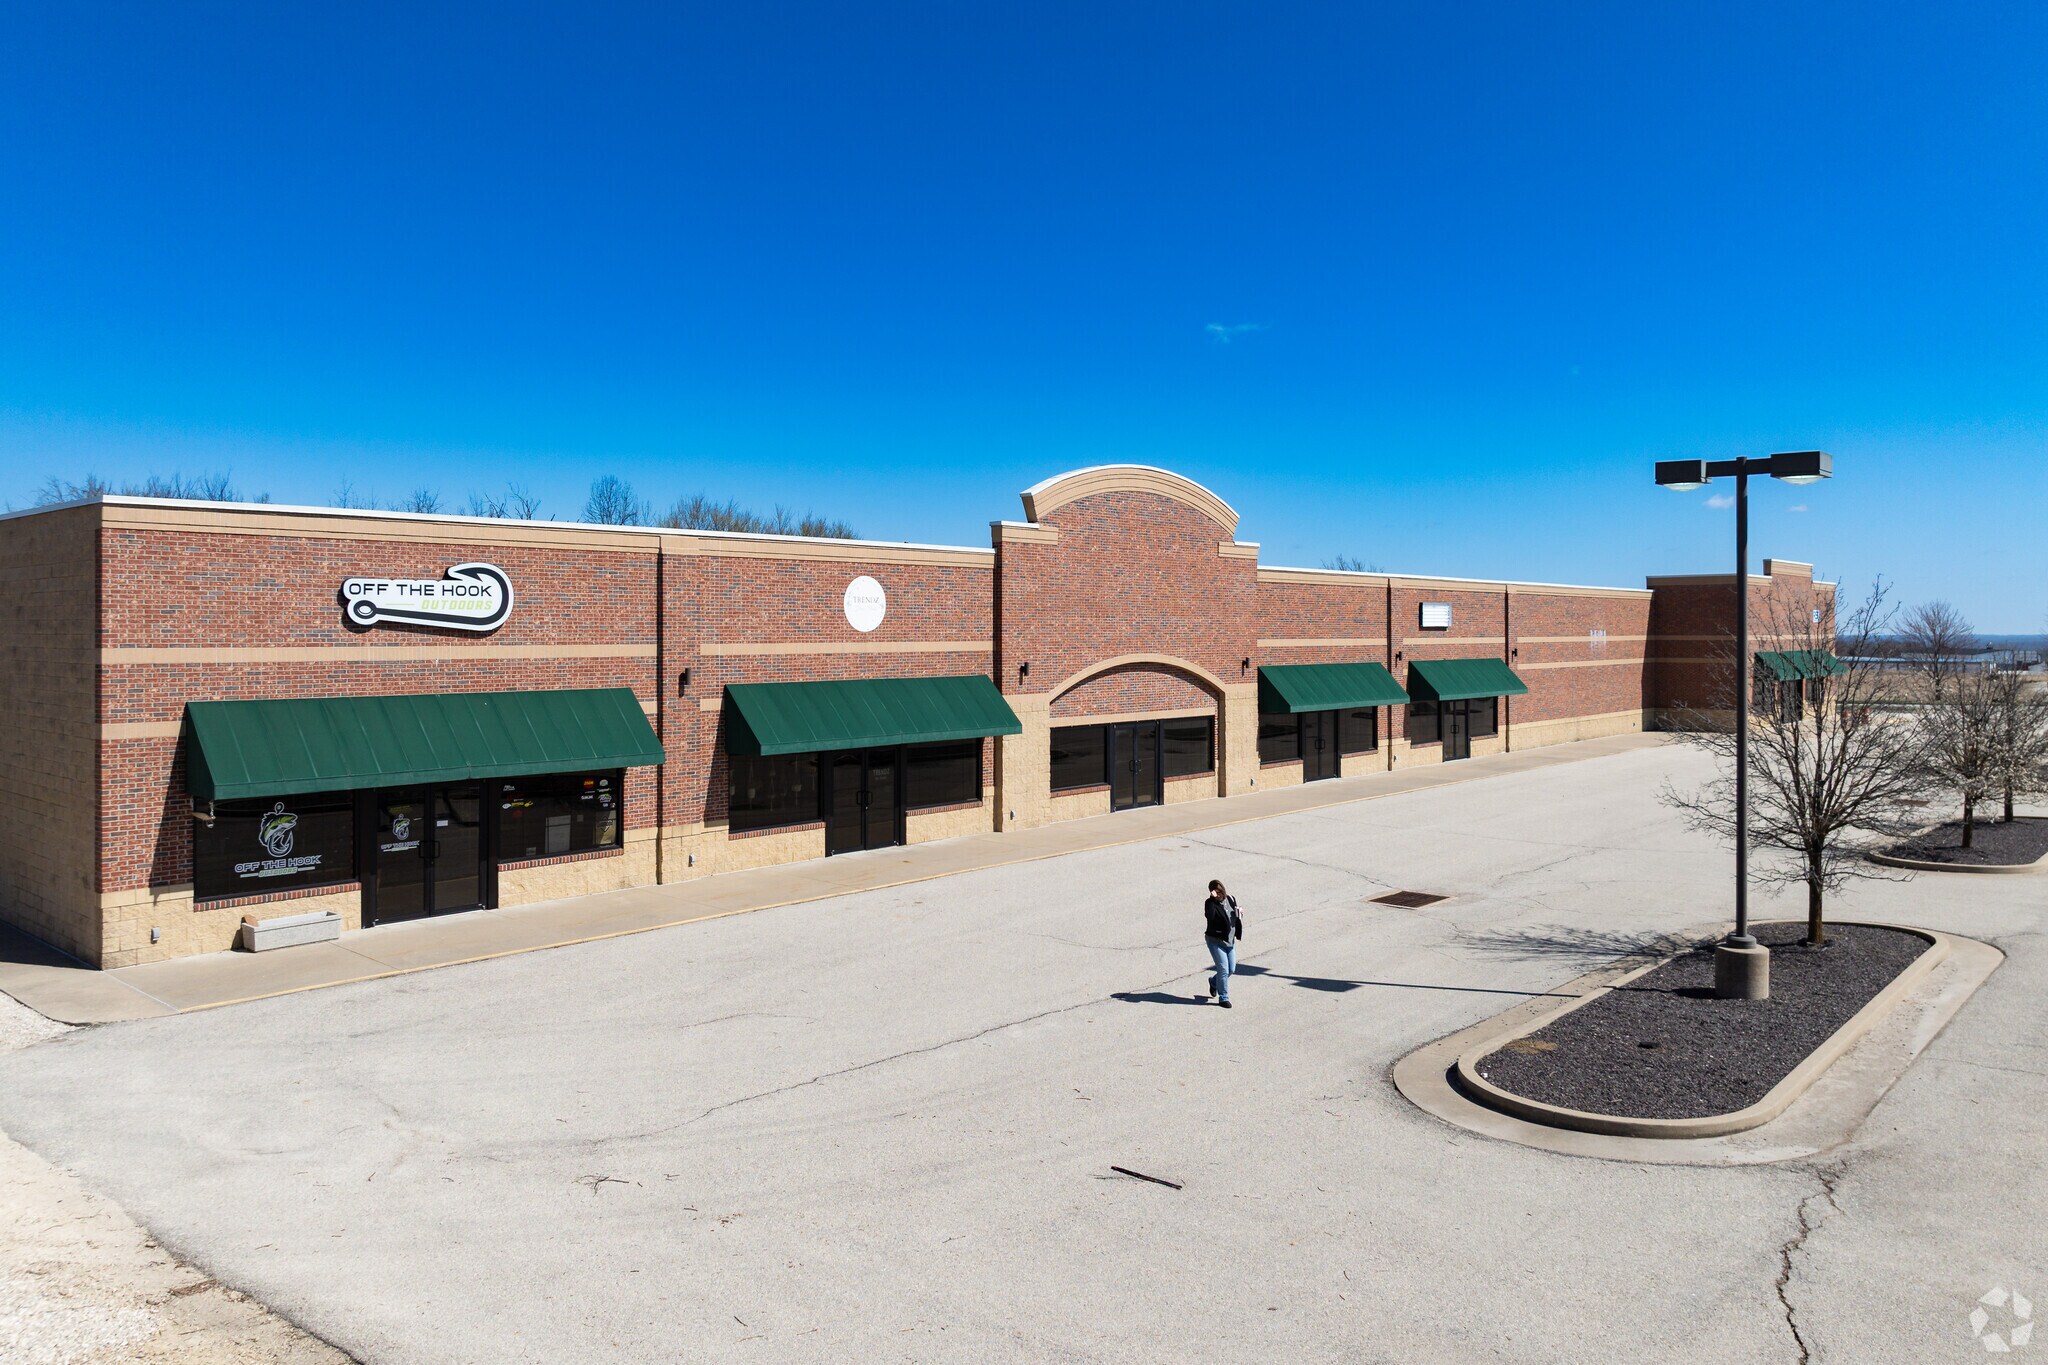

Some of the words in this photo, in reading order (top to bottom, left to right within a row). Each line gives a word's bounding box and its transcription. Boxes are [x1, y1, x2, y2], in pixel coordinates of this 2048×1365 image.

[349, 583, 389, 596] OFF
[396, 584, 435, 596] THE
[442, 585, 492, 597] HOOK
[421, 599, 493, 611] OUTDOORS
[853, 596, 880, 604] TRENDZ
[235, 862, 260, 873] OFF
[262, 859, 287, 870] THE
[288, 854, 322, 867] HOOK
[259, 867, 298, 877] OUTDOORS
